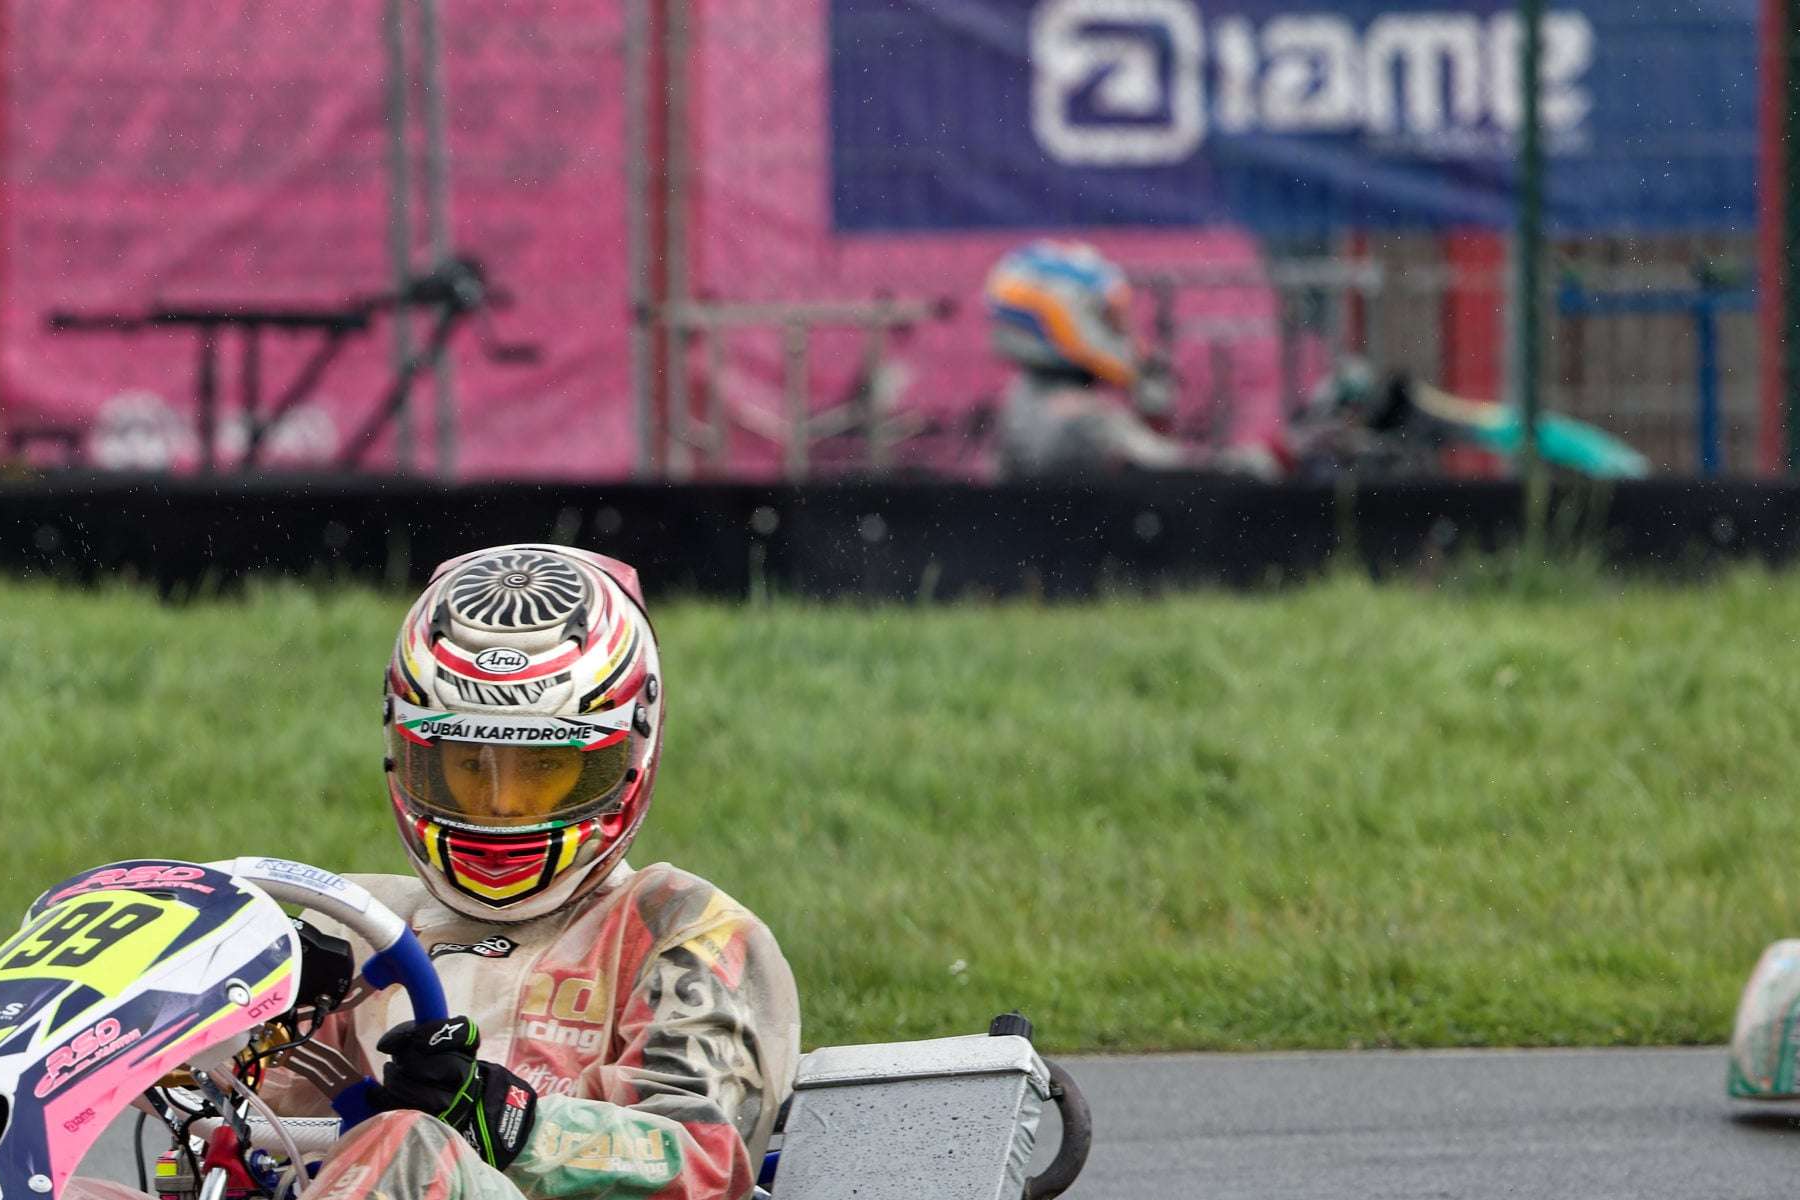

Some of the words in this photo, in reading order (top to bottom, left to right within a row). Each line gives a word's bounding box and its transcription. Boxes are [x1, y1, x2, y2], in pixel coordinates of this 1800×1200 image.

[484, 651, 521, 666] Arai
[419, 719, 470, 739] DUBAI
[473, 724, 593, 741] KARTDROME
[89, 865, 206, 887] RSD
[248, 991, 284, 1019] OTK
[45, 1016, 121, 1073] RSD
